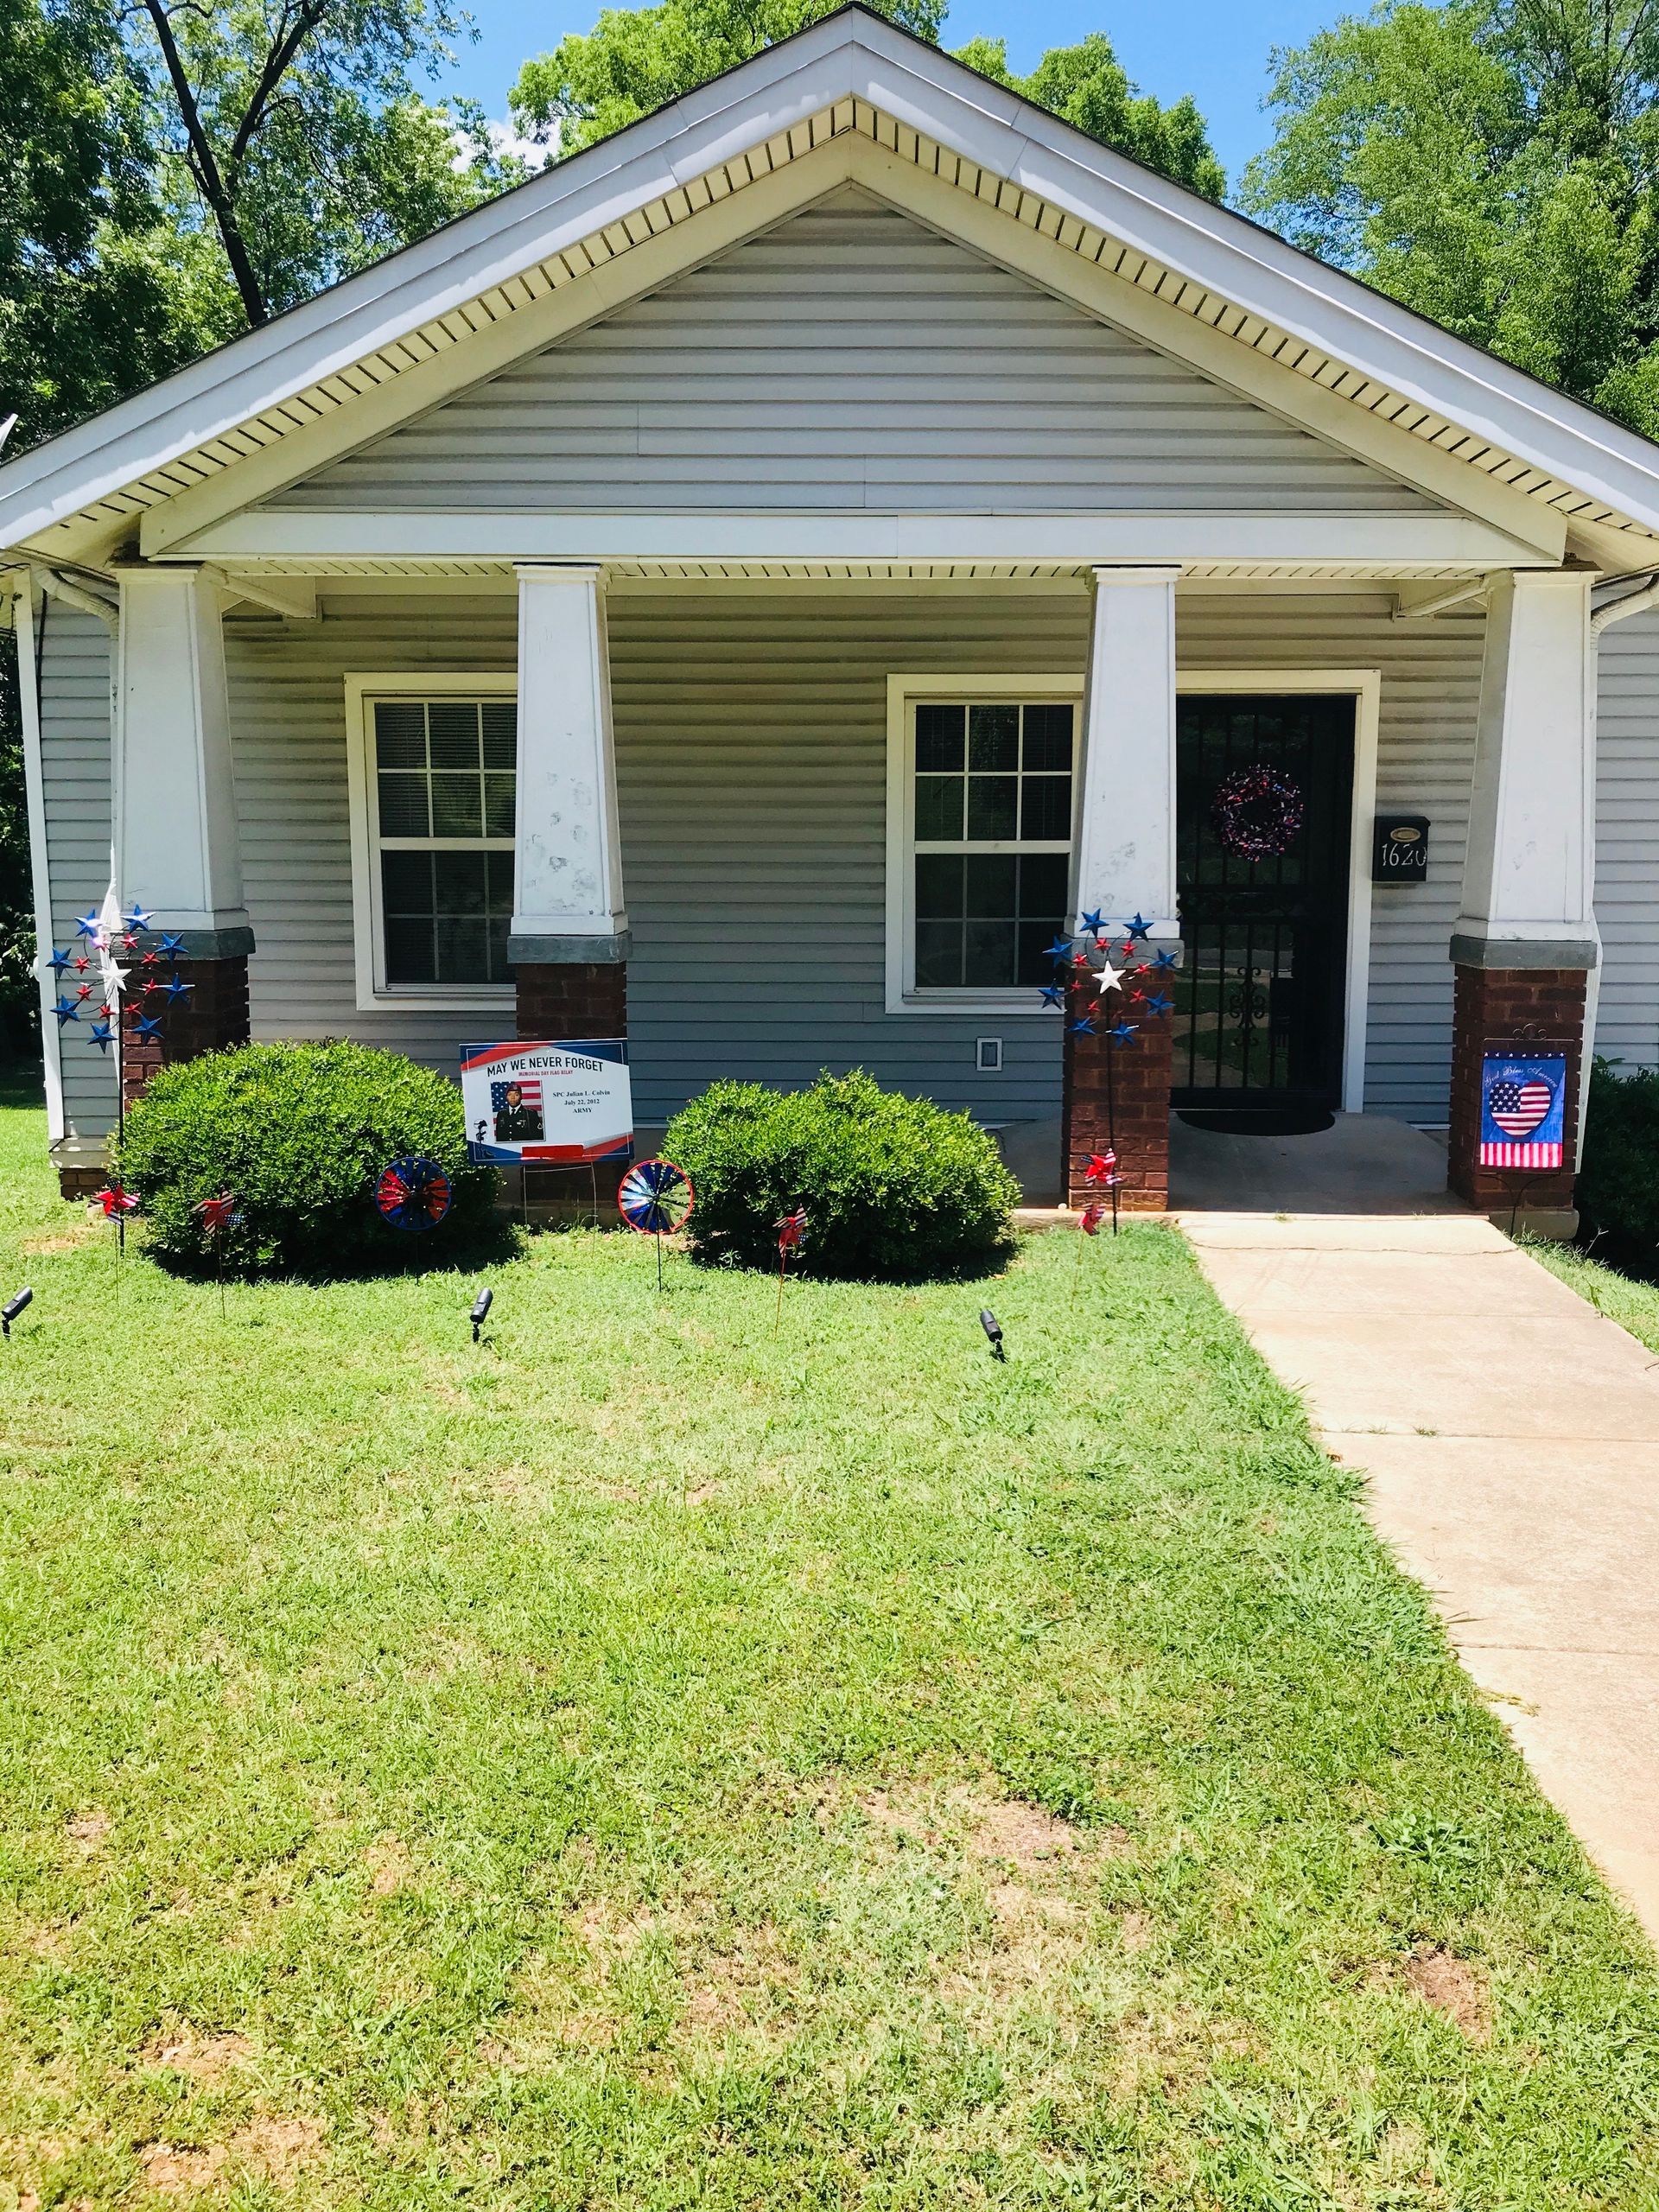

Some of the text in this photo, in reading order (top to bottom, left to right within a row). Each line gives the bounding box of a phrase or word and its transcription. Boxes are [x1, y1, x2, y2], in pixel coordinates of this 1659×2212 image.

[1382, 843, 1427, 866] 1620
[487, 1057, 603, 1077] MAY WE NEVER FORGET
[1484, 1065, 1558, 1088] God Bless America
